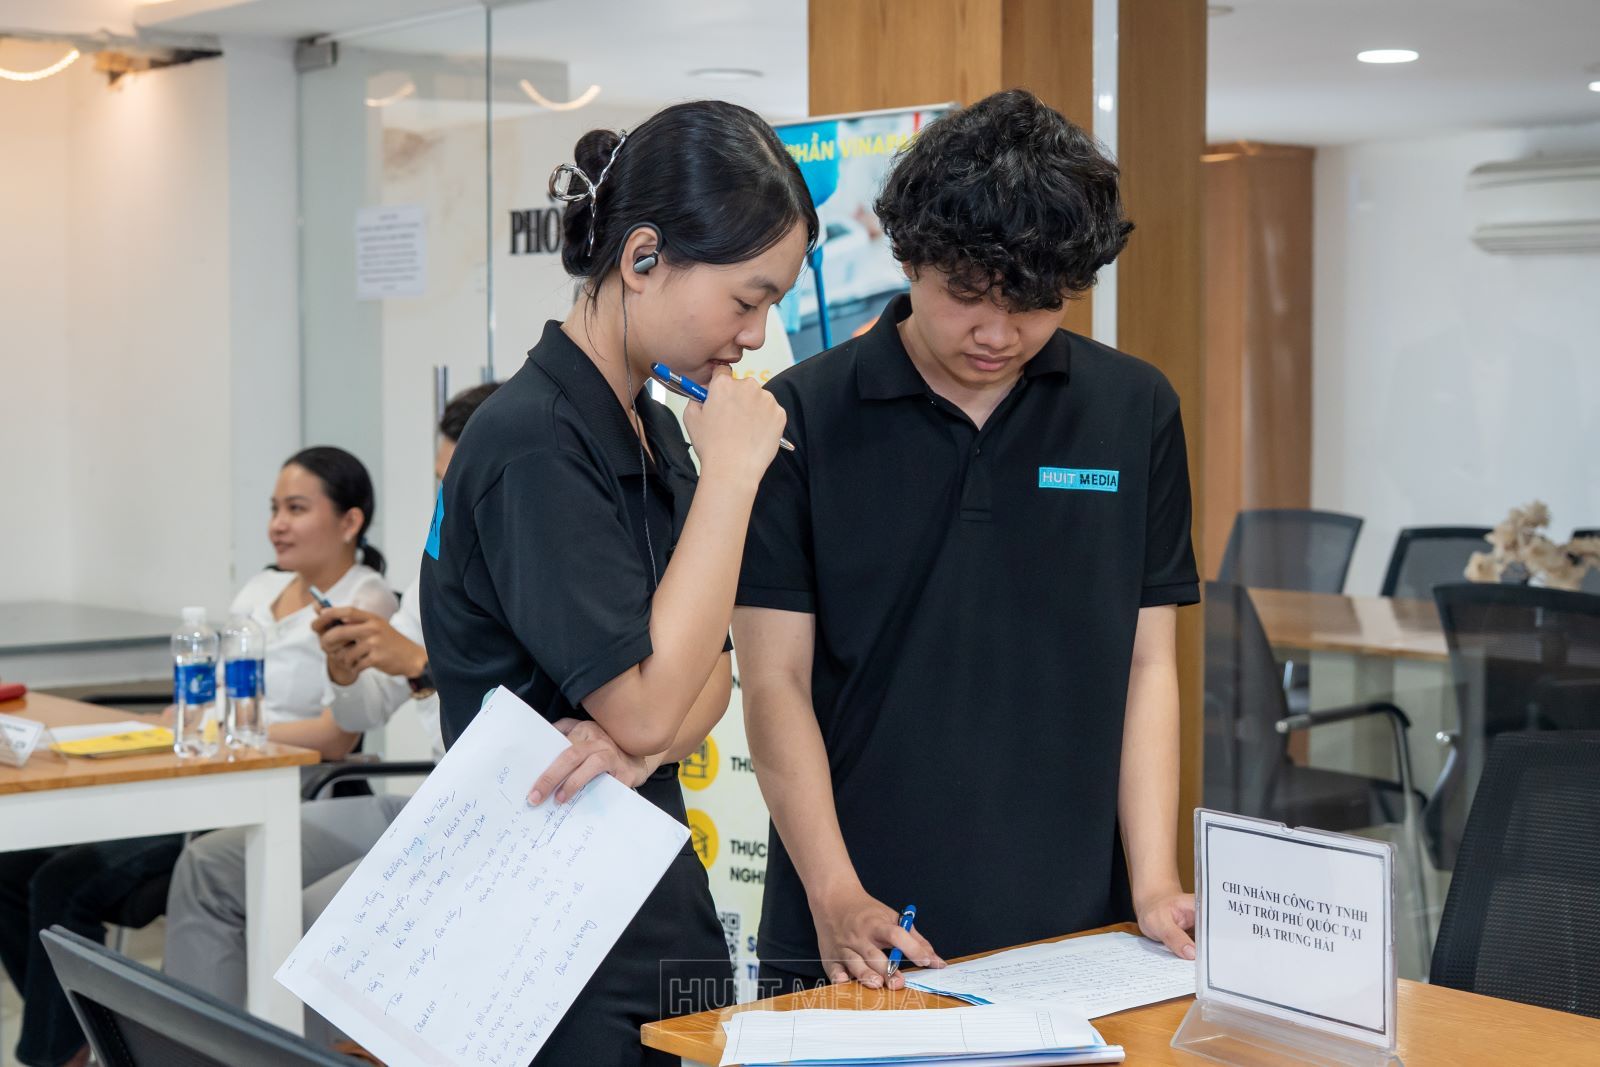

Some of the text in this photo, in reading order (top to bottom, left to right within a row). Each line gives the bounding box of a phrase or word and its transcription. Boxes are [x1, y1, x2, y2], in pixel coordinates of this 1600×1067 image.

[1042, 471, 1117, 487] HUIT MEDIA
[731, 839, 767, 861] THỰC
[1222, 881, 1368, 922] CHI NHÁNH CÔNG TY TNHH
[1252, 923, 1270, 939] ĐỊA
[1273, 928, 1311, 947] TRUNG
[1253, 905, 1279, 922] TRỜI
[1282, 912, 1303, 926] PHÚ
[1342, 925, 1361, 941] TẠI
